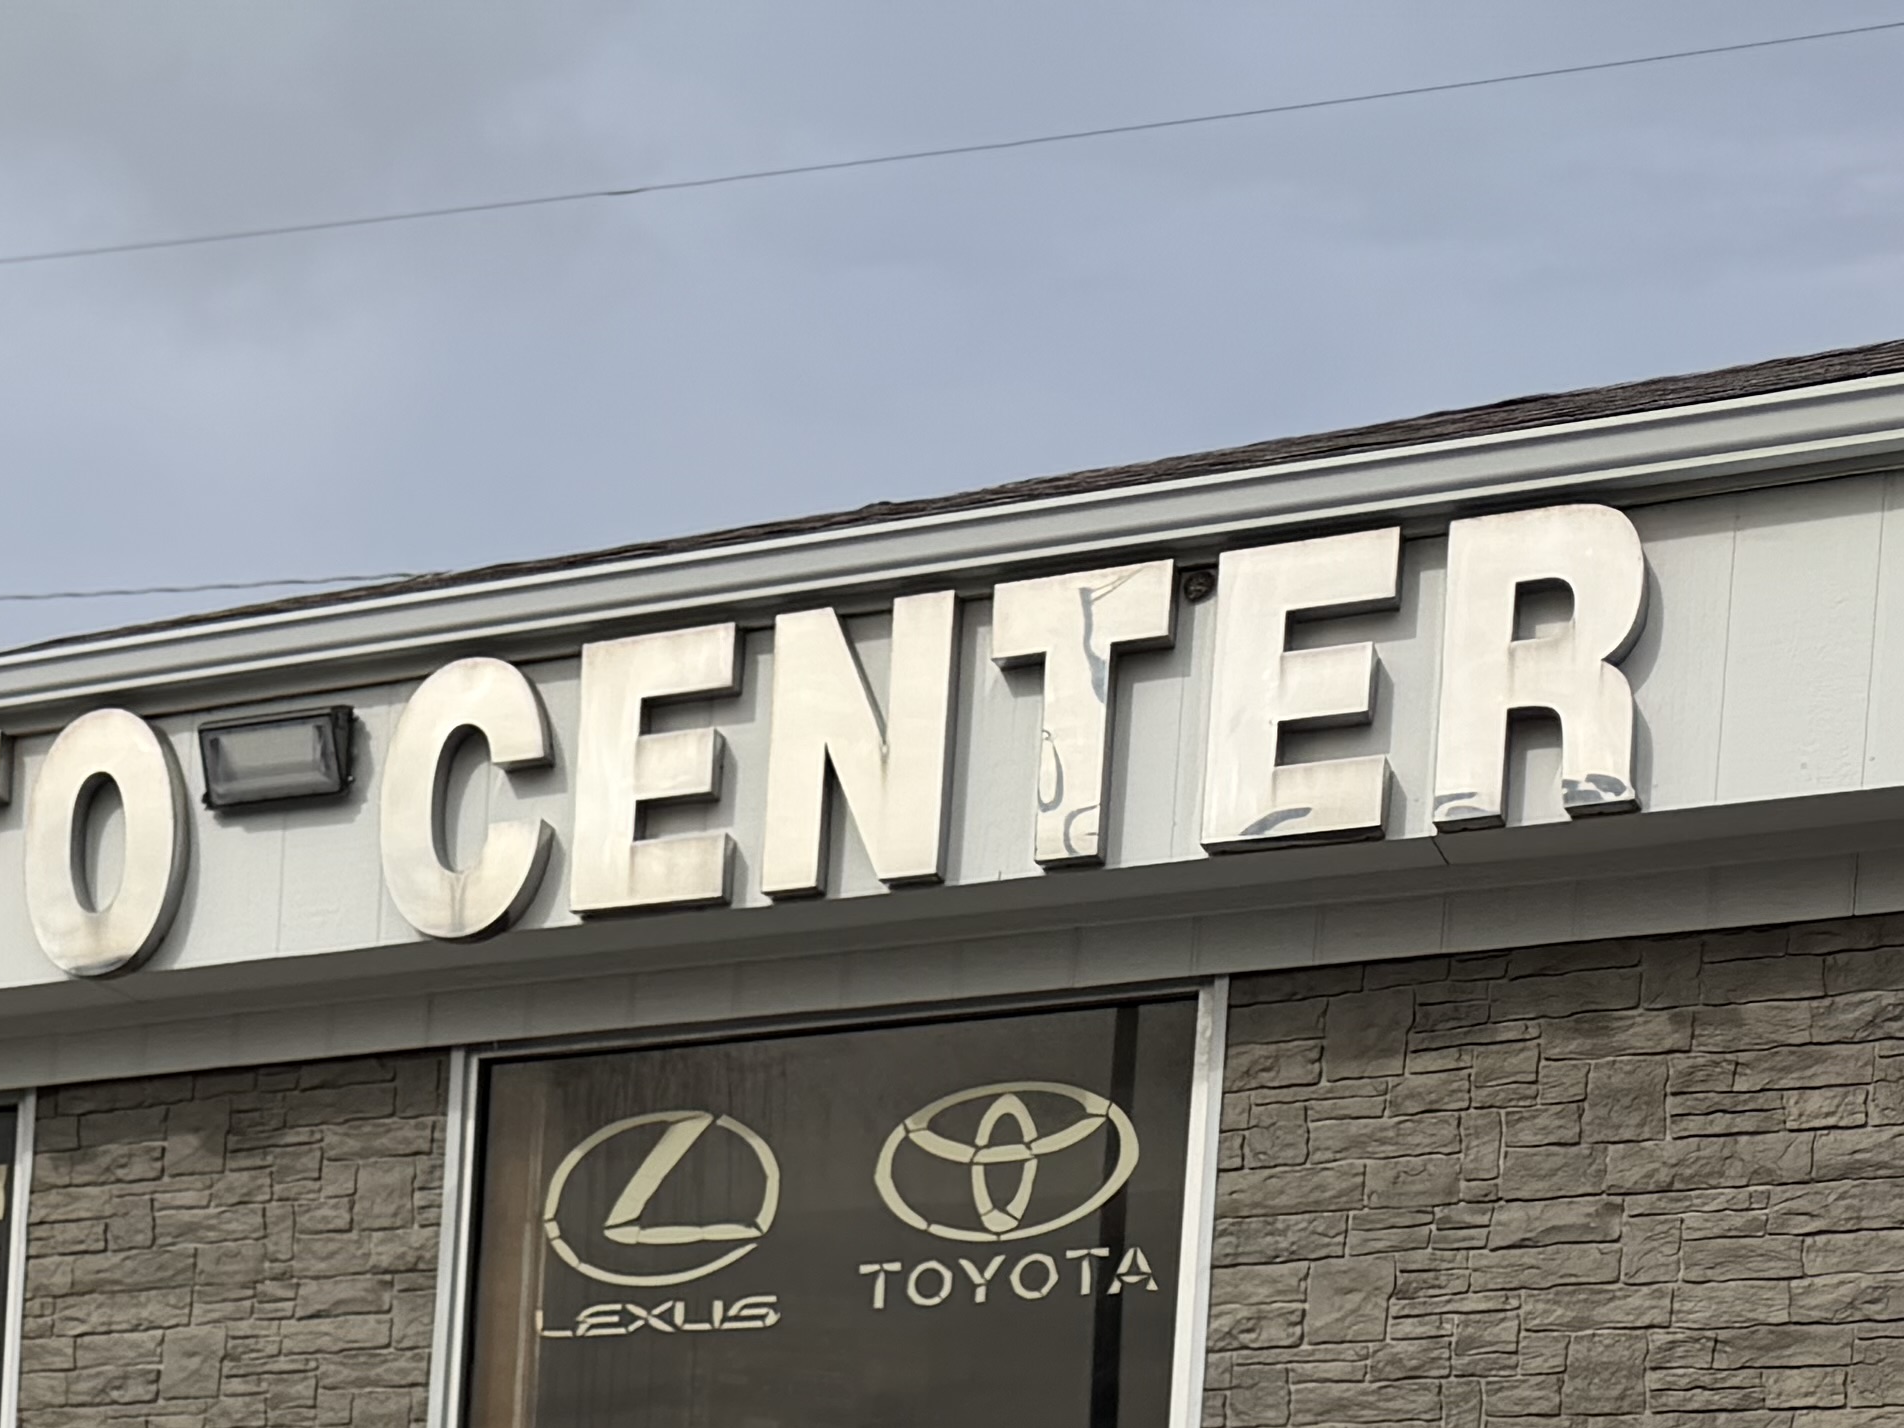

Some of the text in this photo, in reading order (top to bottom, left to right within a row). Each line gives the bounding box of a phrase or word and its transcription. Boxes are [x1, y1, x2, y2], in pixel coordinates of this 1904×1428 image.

[377, 500, 1654, 948] CENTER
[859, 1247, 1158, 1309] TOYOTA
[535, 1295, 781, 1337] LEXUS
